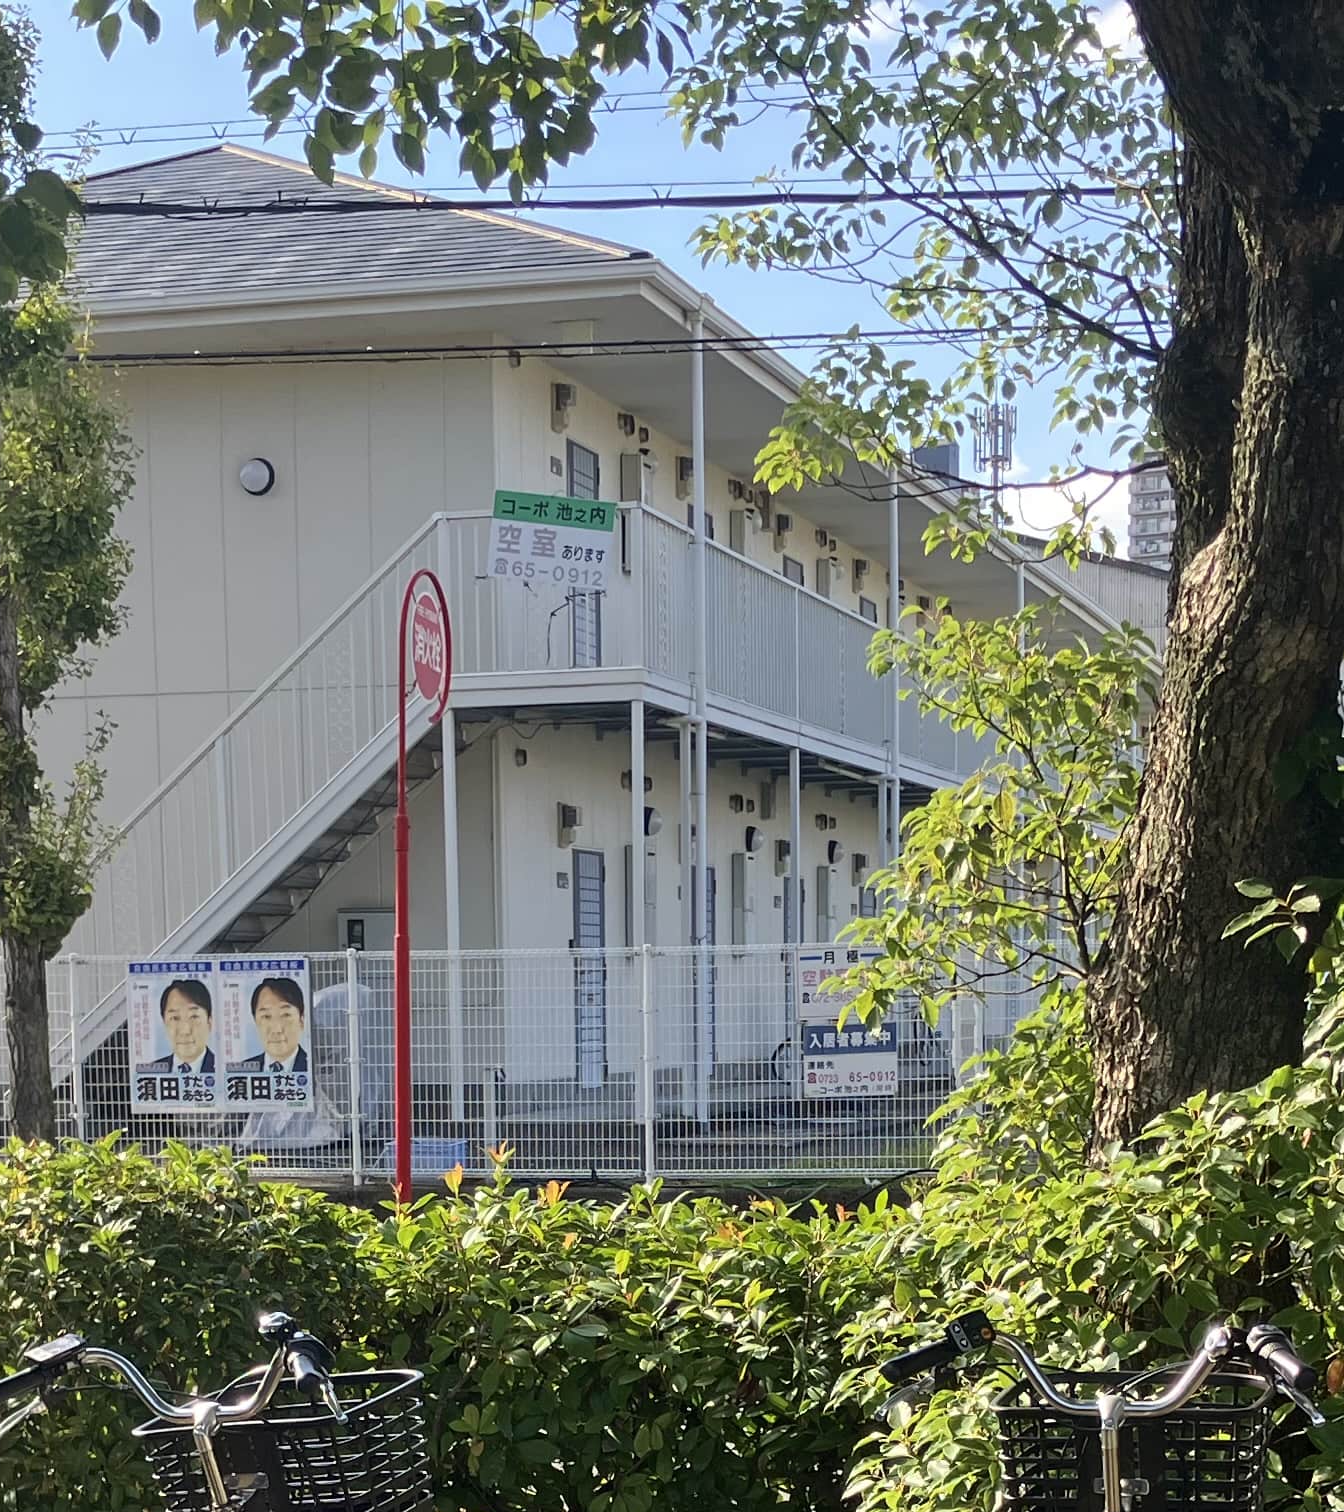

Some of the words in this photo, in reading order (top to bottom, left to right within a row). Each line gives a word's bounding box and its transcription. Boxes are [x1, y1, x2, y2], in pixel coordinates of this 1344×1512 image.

[556, 502, 607, 525] 池之内
[561, 545, 606, 564] あります
[512, 561, 603, 587] 65-0912
[414, 622, 442, 673] 消火栓
[823, 949, 860, 965] 月極
[809, 1029, 892, 1049] 入居者募集中
[136, 1076, 180, 1102] 須田
[181, 1075, 203, 1088] すだ
[226, 1075, 272, 1101] 須田
[273, 1073, 296, 1088] すだ
[182, 1089, 215, 1102] あきら
[273, 1087, 307, 1101] あきら
